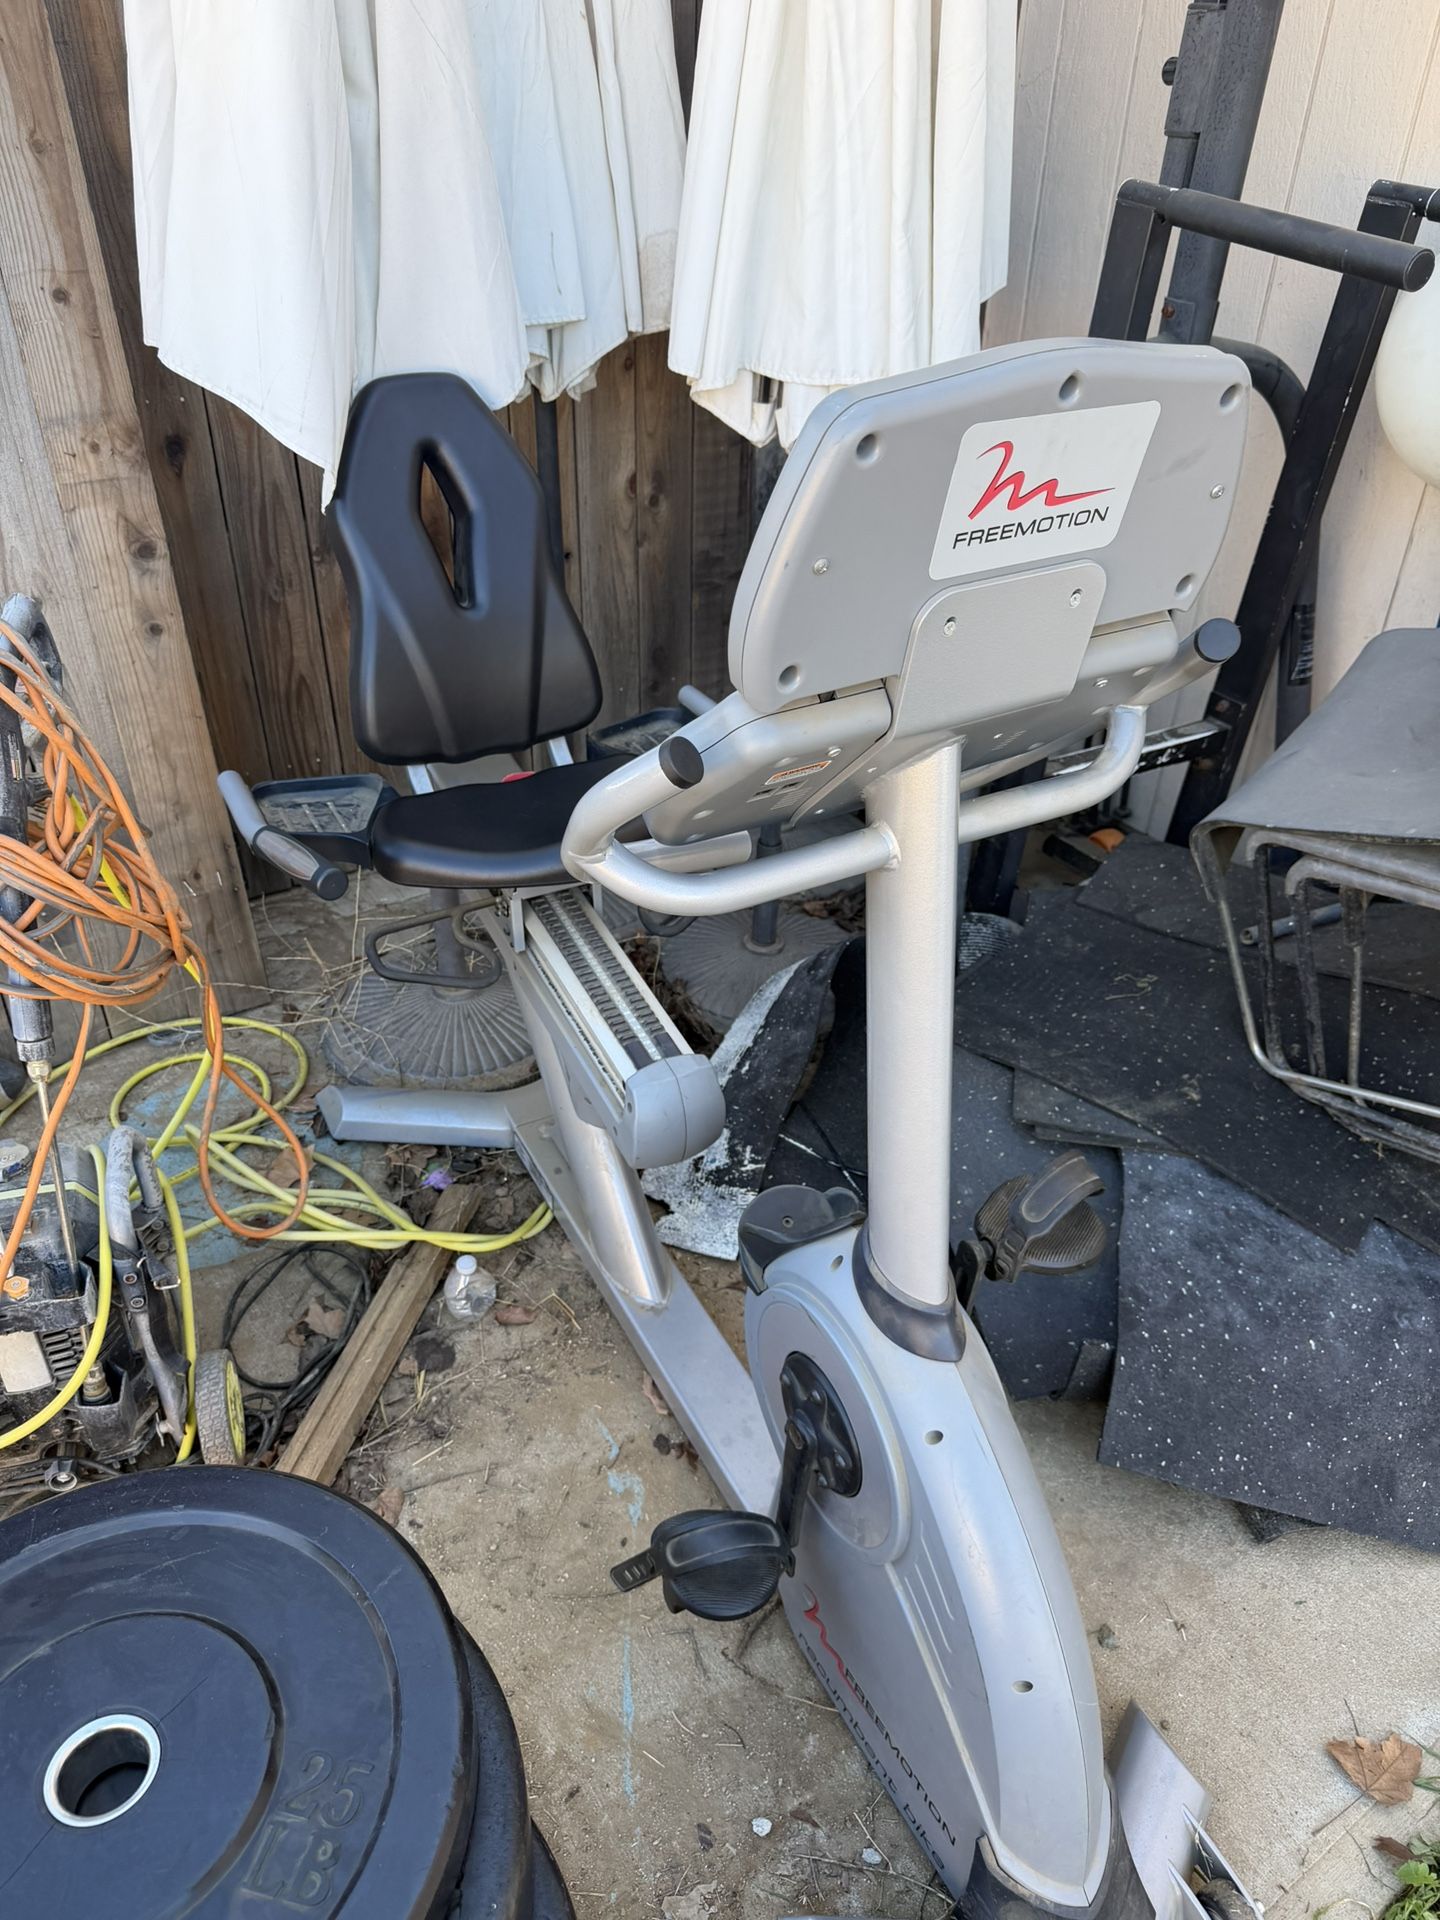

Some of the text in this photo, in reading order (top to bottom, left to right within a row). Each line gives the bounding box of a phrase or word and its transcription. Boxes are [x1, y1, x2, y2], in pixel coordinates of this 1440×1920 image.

[952, 506, 1109, 549] FREEMOTION
[284, 1751, 376, 1829] 25
[798, 1632, 945, 1870] recumbent bike
[844, 1667, 956, 1847] FREEMOTION
